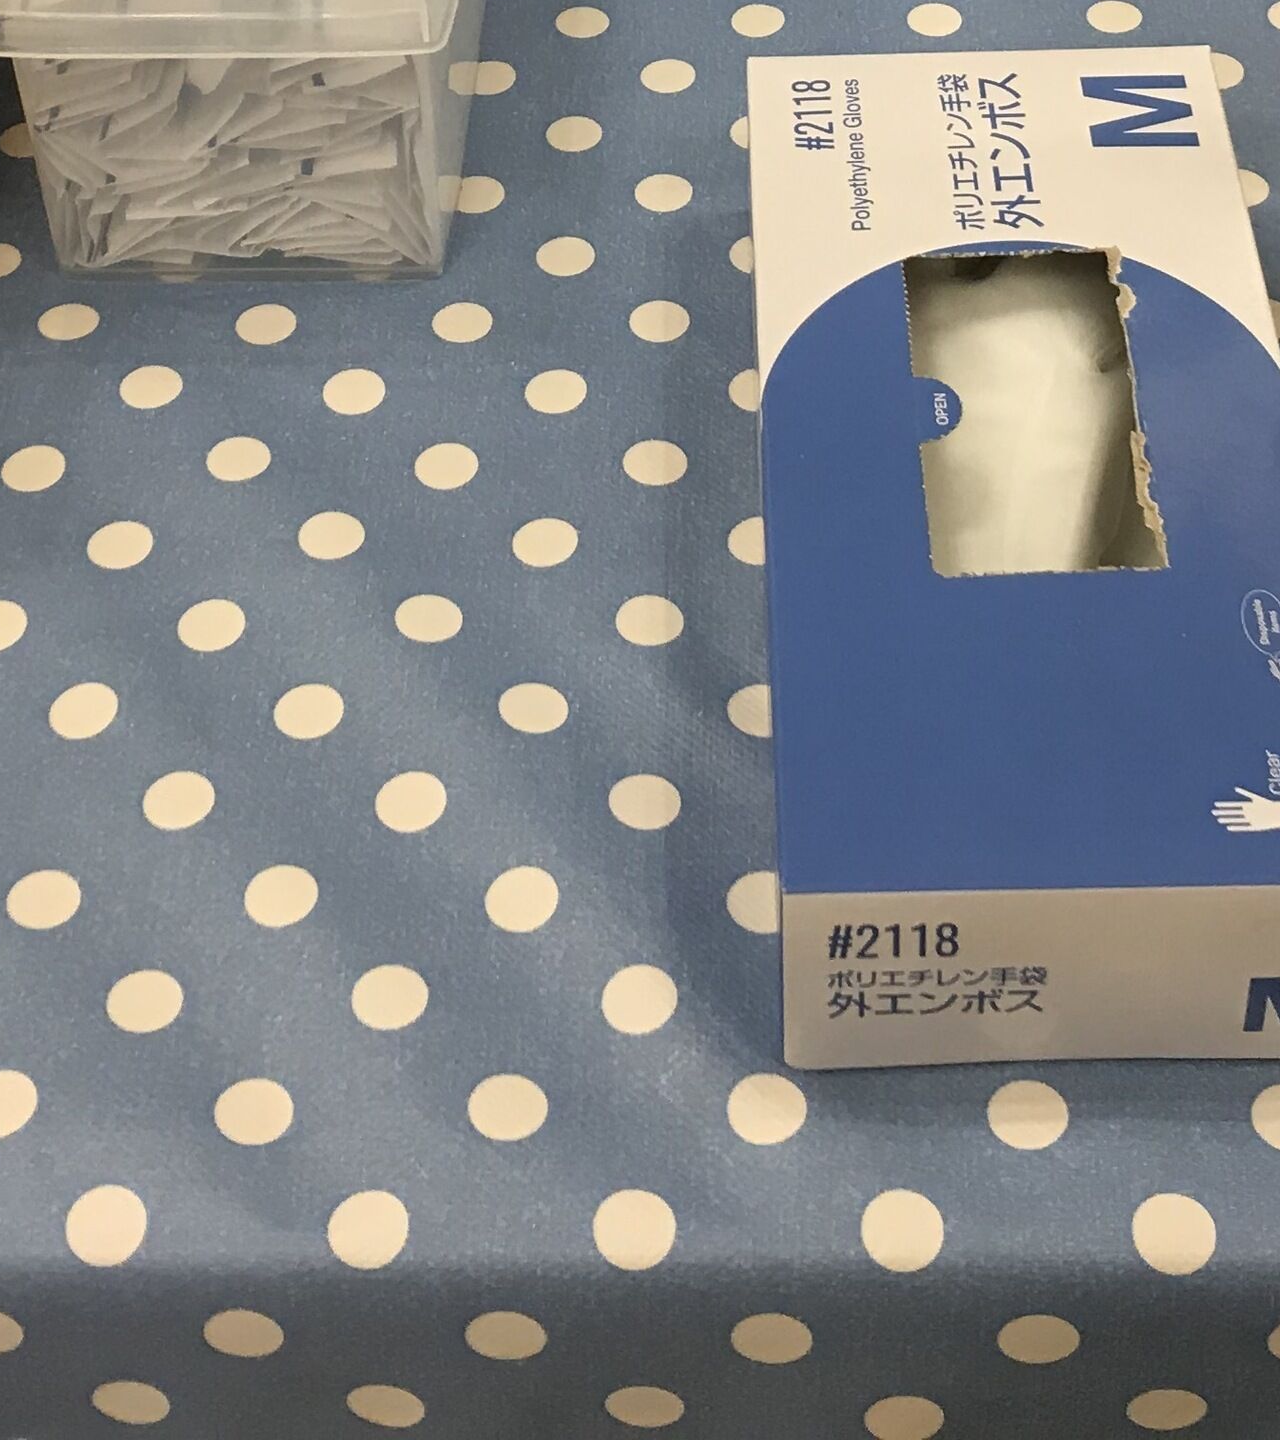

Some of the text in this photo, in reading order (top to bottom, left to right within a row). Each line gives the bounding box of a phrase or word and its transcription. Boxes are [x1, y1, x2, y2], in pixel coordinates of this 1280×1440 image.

[792, 78, 836, 152] #2118
[1079, 73, 1201, 148] M
[843, 78, 873, 232] Polyethylene Gloves
[936, 72, 986, 231] ポリエチレン手袋
[977, 72, 1045, 229] 外エンボス
[935, 392, 949, 426] OPEN
[826, 965, 1048, 988] ポリエチレン手袋
[827, 921, 960, 960] #2118
[826, 990, 1045, 1018] 外エンボス
